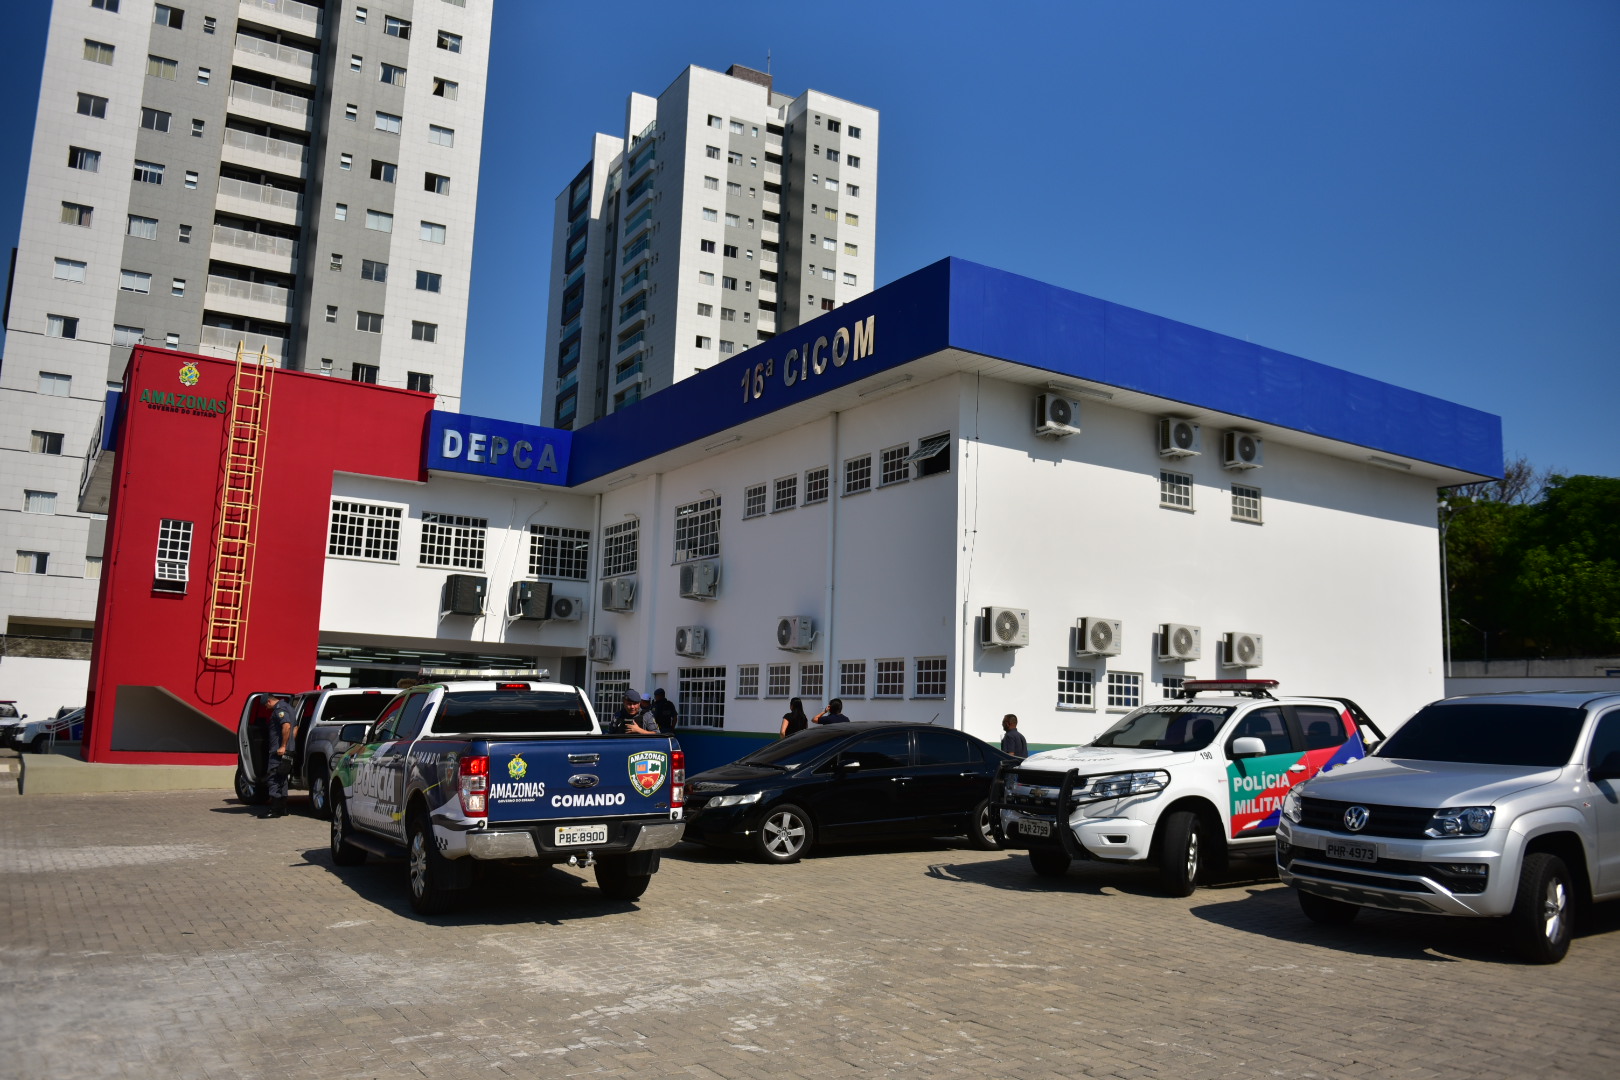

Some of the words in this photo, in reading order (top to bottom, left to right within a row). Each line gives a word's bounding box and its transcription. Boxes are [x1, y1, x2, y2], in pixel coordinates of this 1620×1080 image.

[741, 358, 774, 403] 16ª
[784, 315, 875, 387] CICOM
[139, 388, 227, 414] AMAZONAS
[148, 404, 180, 414] GOVERNO
[442, 428, 558, 473] DEPCA
[1137, 705, 1179, 715] POLÍCIA
[1180, 705, 1228, 715] MILITAR
[630, 753, 665, 764] AMAZONAS
[1200, 751, 1213, 760] 190
[354, 763, 396, 803] POLÍCIA
[1233, 771, 1291, 793] POLÍCIA
[489, 782, 546, 799] AMAZONAS
[551, 792, 626, 808] COMANDO
[1327, 844, 1374, 860] PHR-4973
